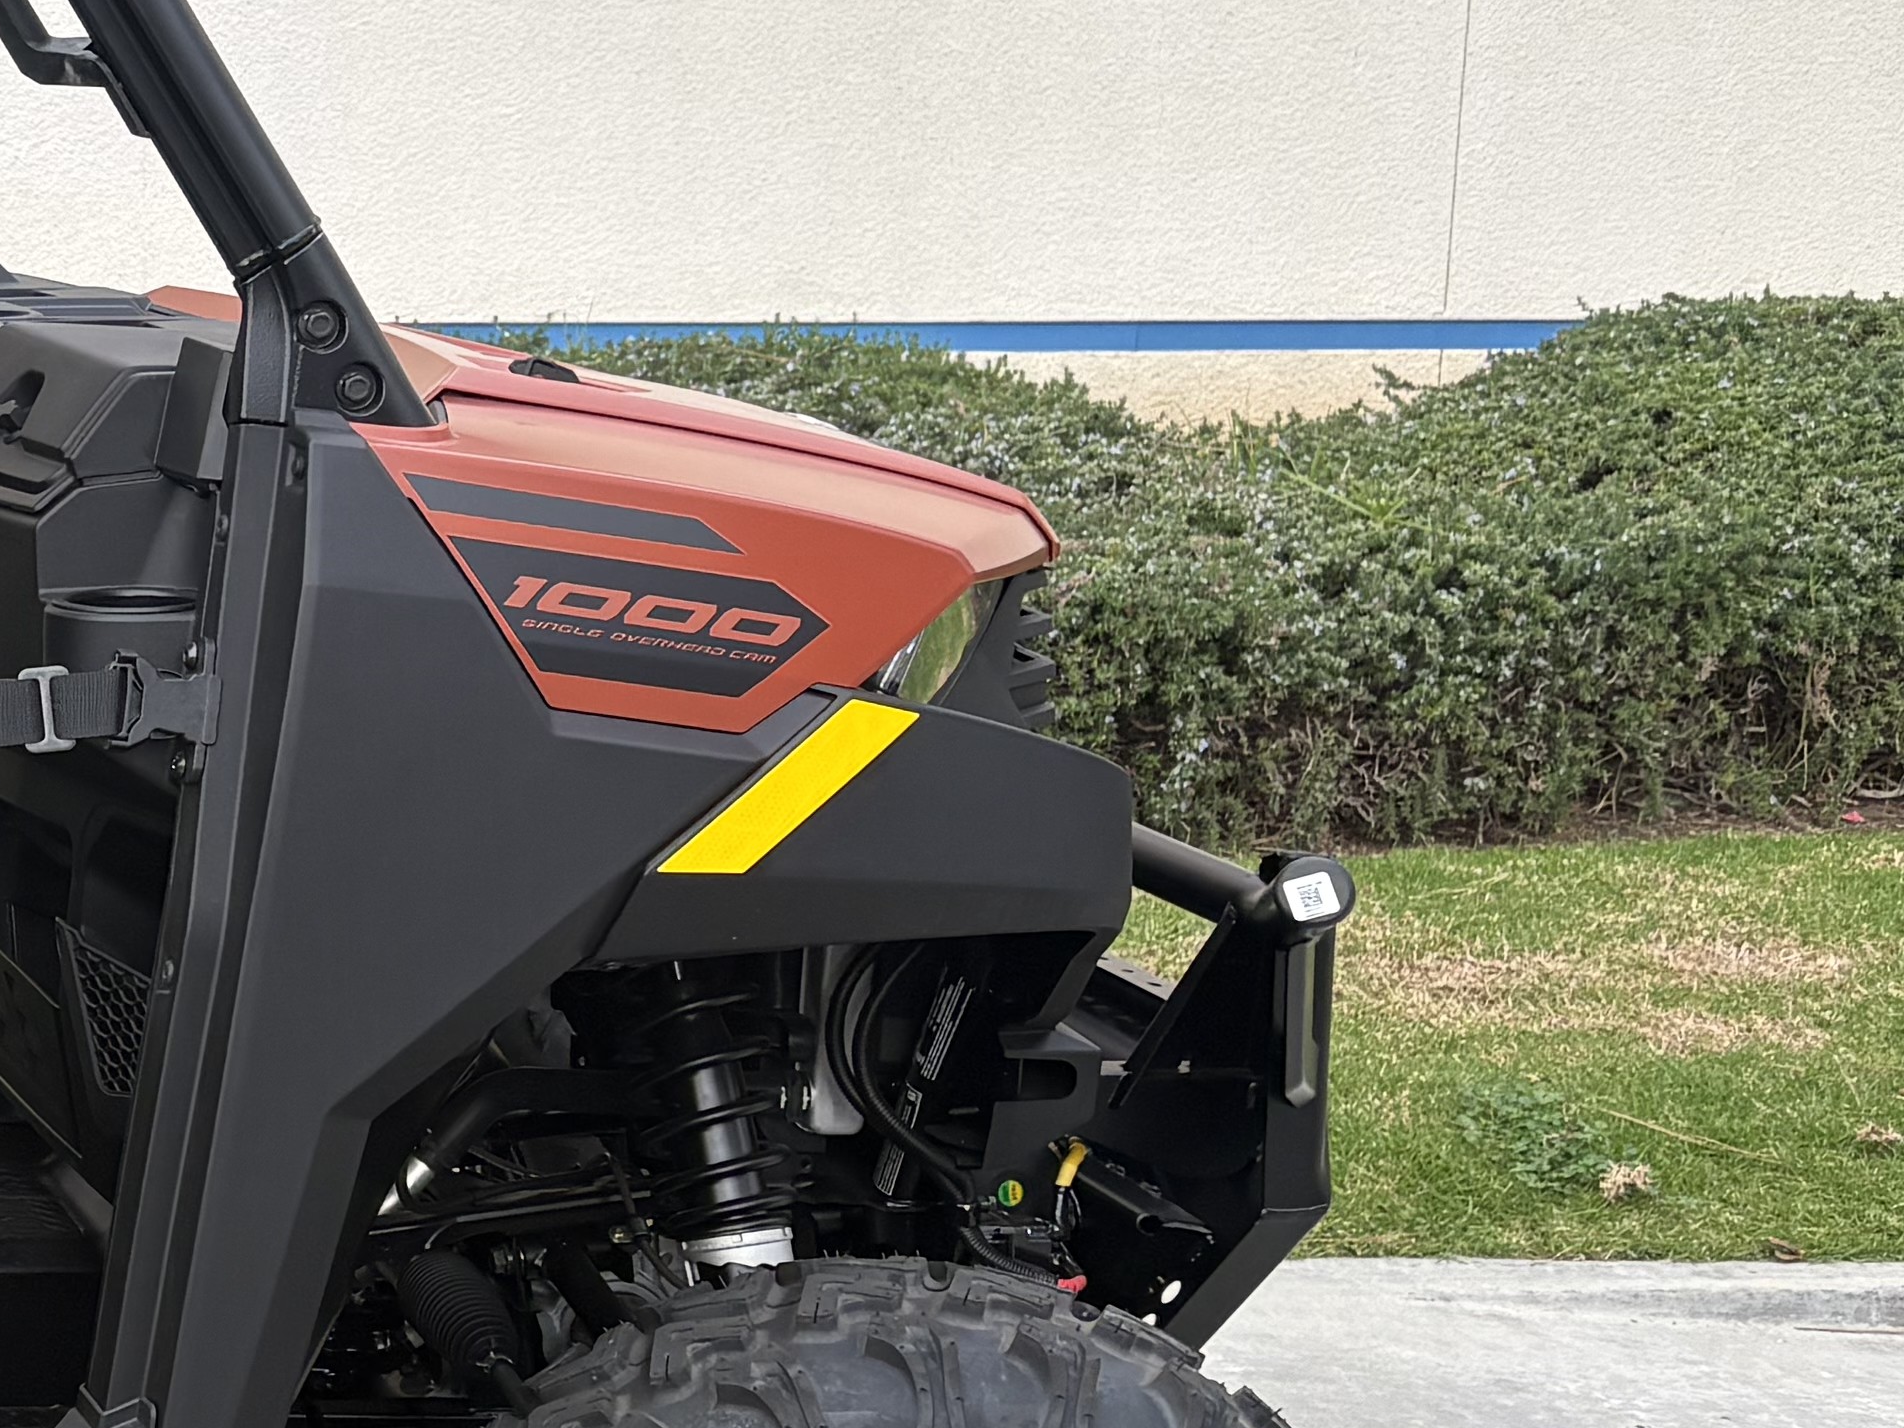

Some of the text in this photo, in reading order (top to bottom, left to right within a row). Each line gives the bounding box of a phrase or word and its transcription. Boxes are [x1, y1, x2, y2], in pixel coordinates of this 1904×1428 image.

[503, 575, 802, 647] 1000
[521, 618, 778, 665] SINGLE OVERHEAD CAM
